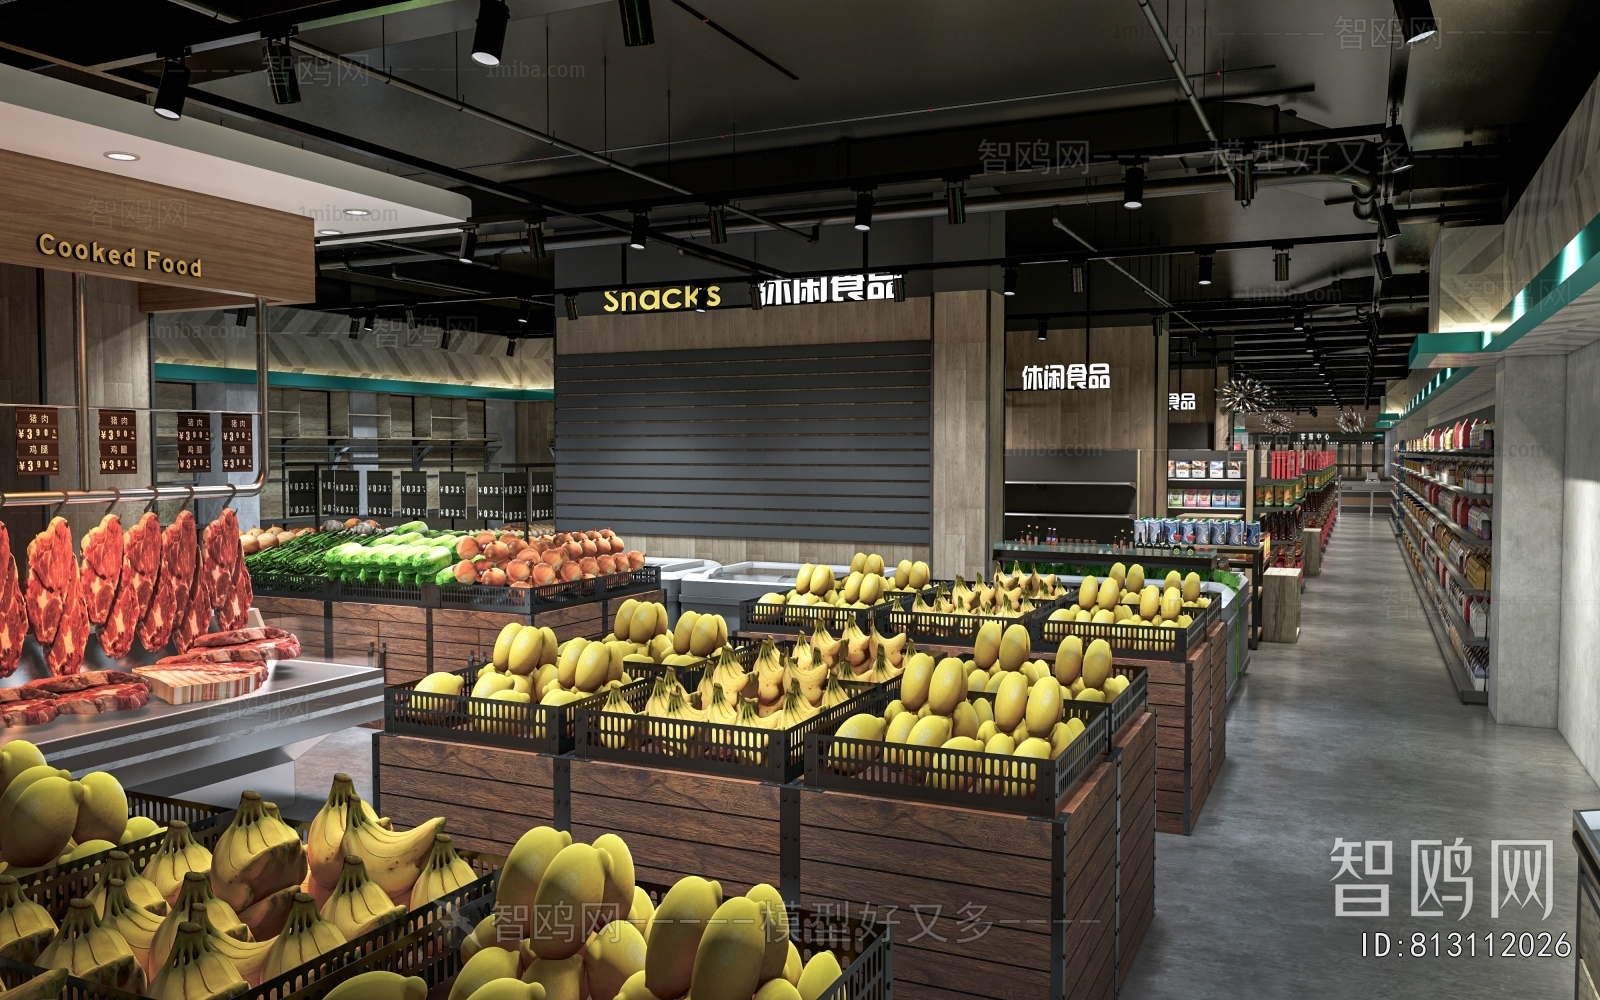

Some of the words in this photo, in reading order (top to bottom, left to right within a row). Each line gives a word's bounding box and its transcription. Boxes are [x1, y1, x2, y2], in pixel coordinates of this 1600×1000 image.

[37, 233, 136, 267] Cooked
[146, 250, 202, 277] Food
[603, 284, 721, 313] Snacks
[1021, 362, 1111, 391] 休闲食品
